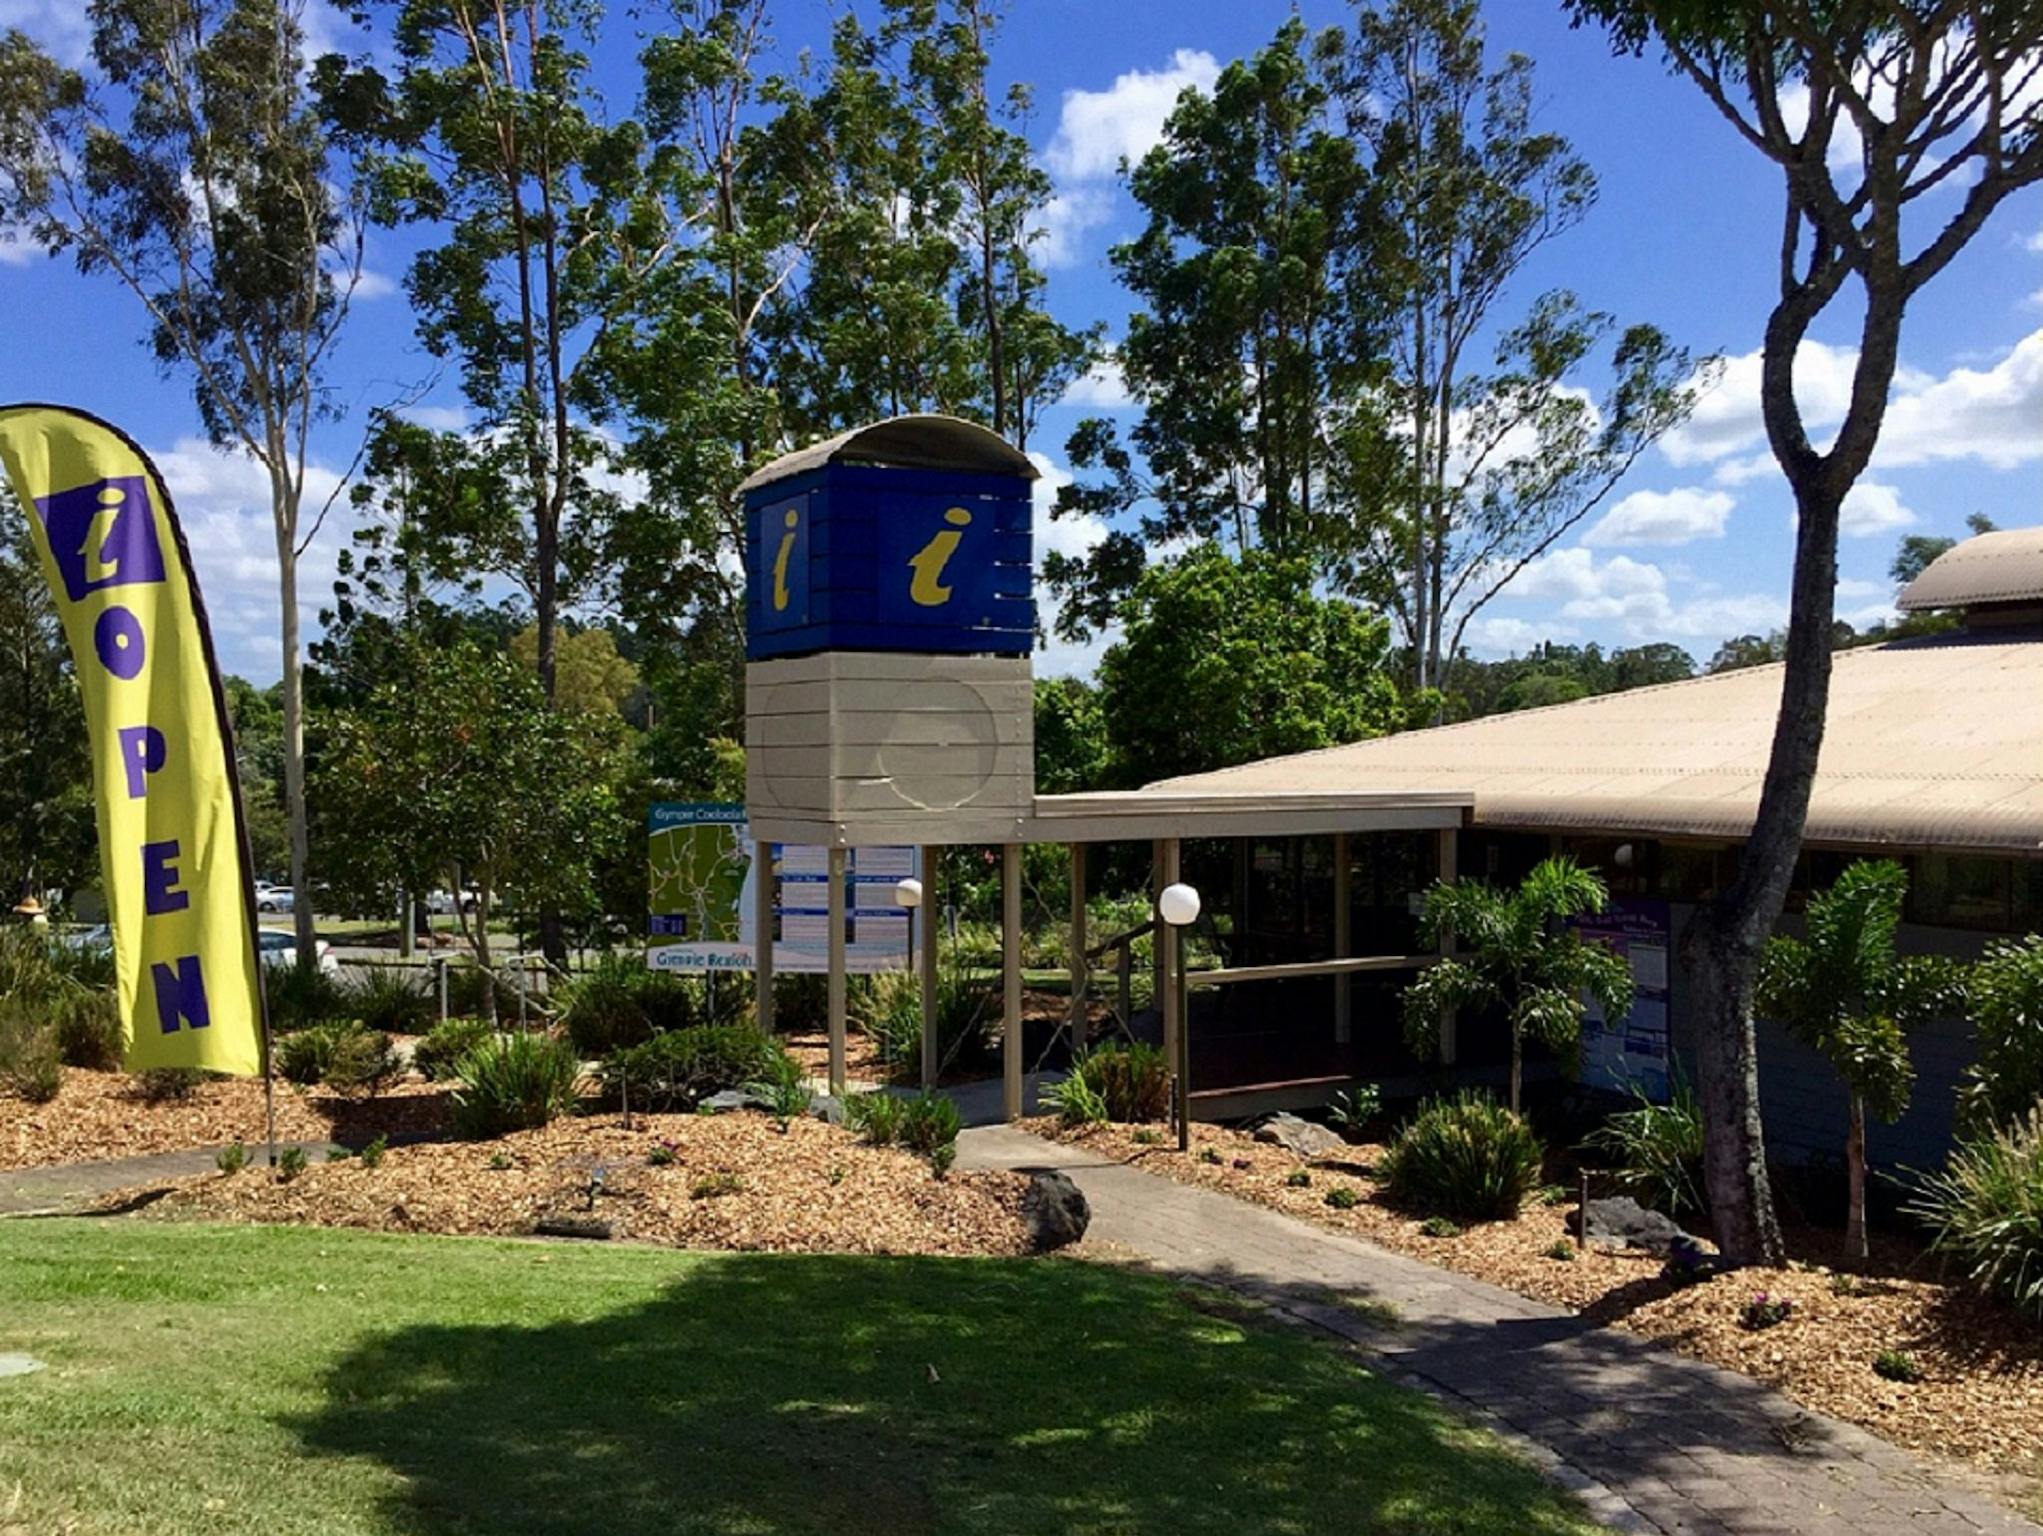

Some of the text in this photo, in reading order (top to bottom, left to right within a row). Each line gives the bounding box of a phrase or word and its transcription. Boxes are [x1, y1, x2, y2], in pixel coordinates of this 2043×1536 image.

[77, 485, 126, 583] i
[773, 508, 798, 612] i
[907, 507, 972, 607] i
[94, 605, 211, 1036] OPEN
